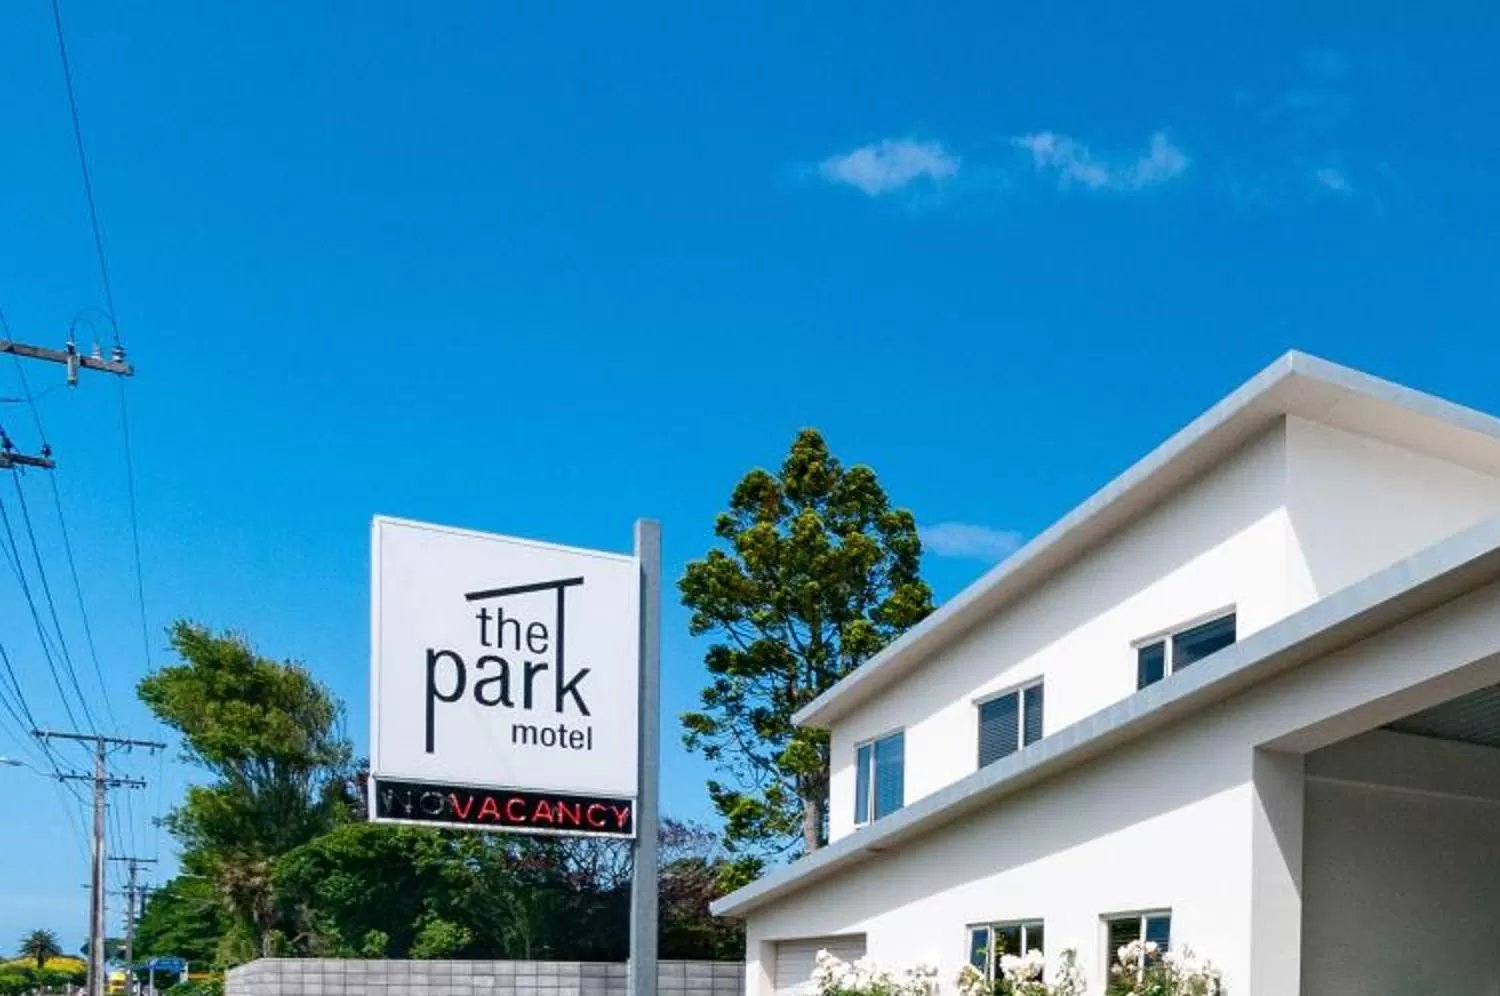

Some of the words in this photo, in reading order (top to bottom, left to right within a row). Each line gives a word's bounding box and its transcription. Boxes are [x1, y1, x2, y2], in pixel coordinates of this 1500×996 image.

[476, 606, 549, 655] the
[425, 584, 592, 754] park
[511, 723, 592, 751] motel
[449, 792, 630, 829] VACANCY
